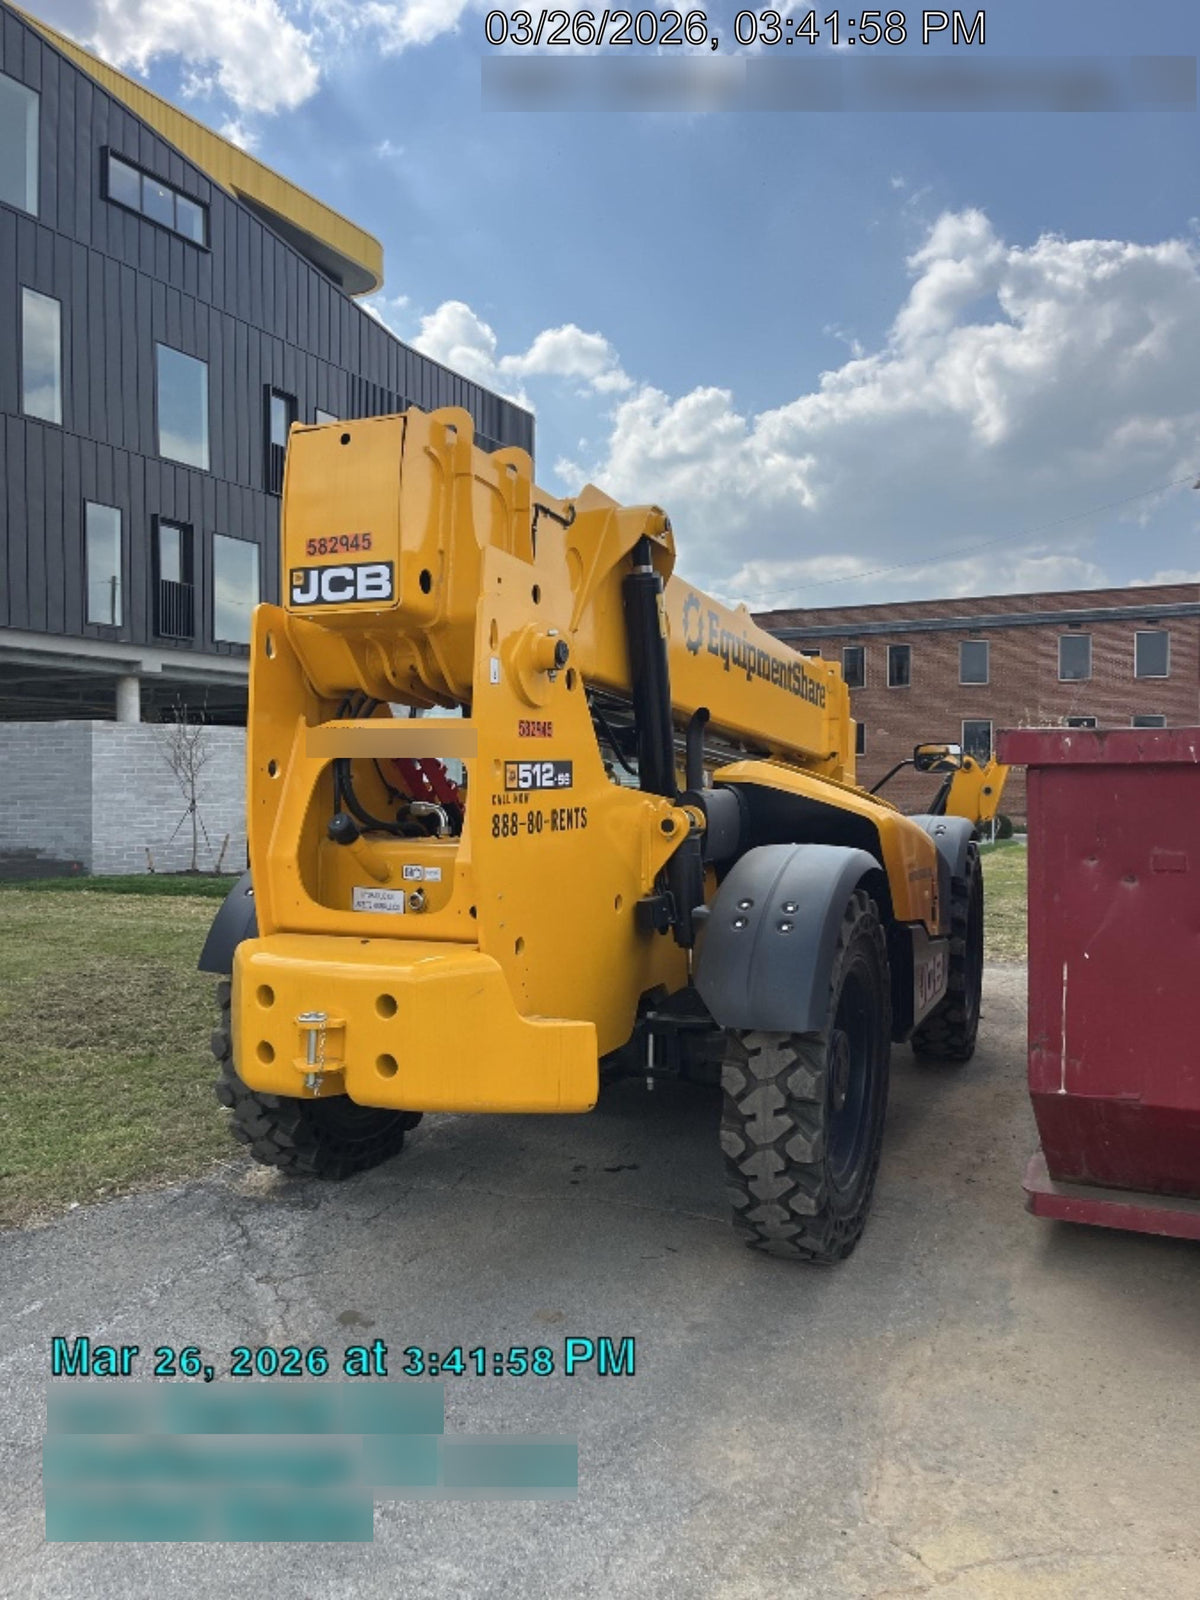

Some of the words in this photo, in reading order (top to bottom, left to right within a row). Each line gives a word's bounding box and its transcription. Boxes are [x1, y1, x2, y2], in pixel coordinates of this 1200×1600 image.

[306, 533, 371, 556] 582945
[293, 565, 392, 604] JCB
[707, 609, 826, 710] EquipmentShare
[492, 807, 588, 838] 888-80-RENTS
